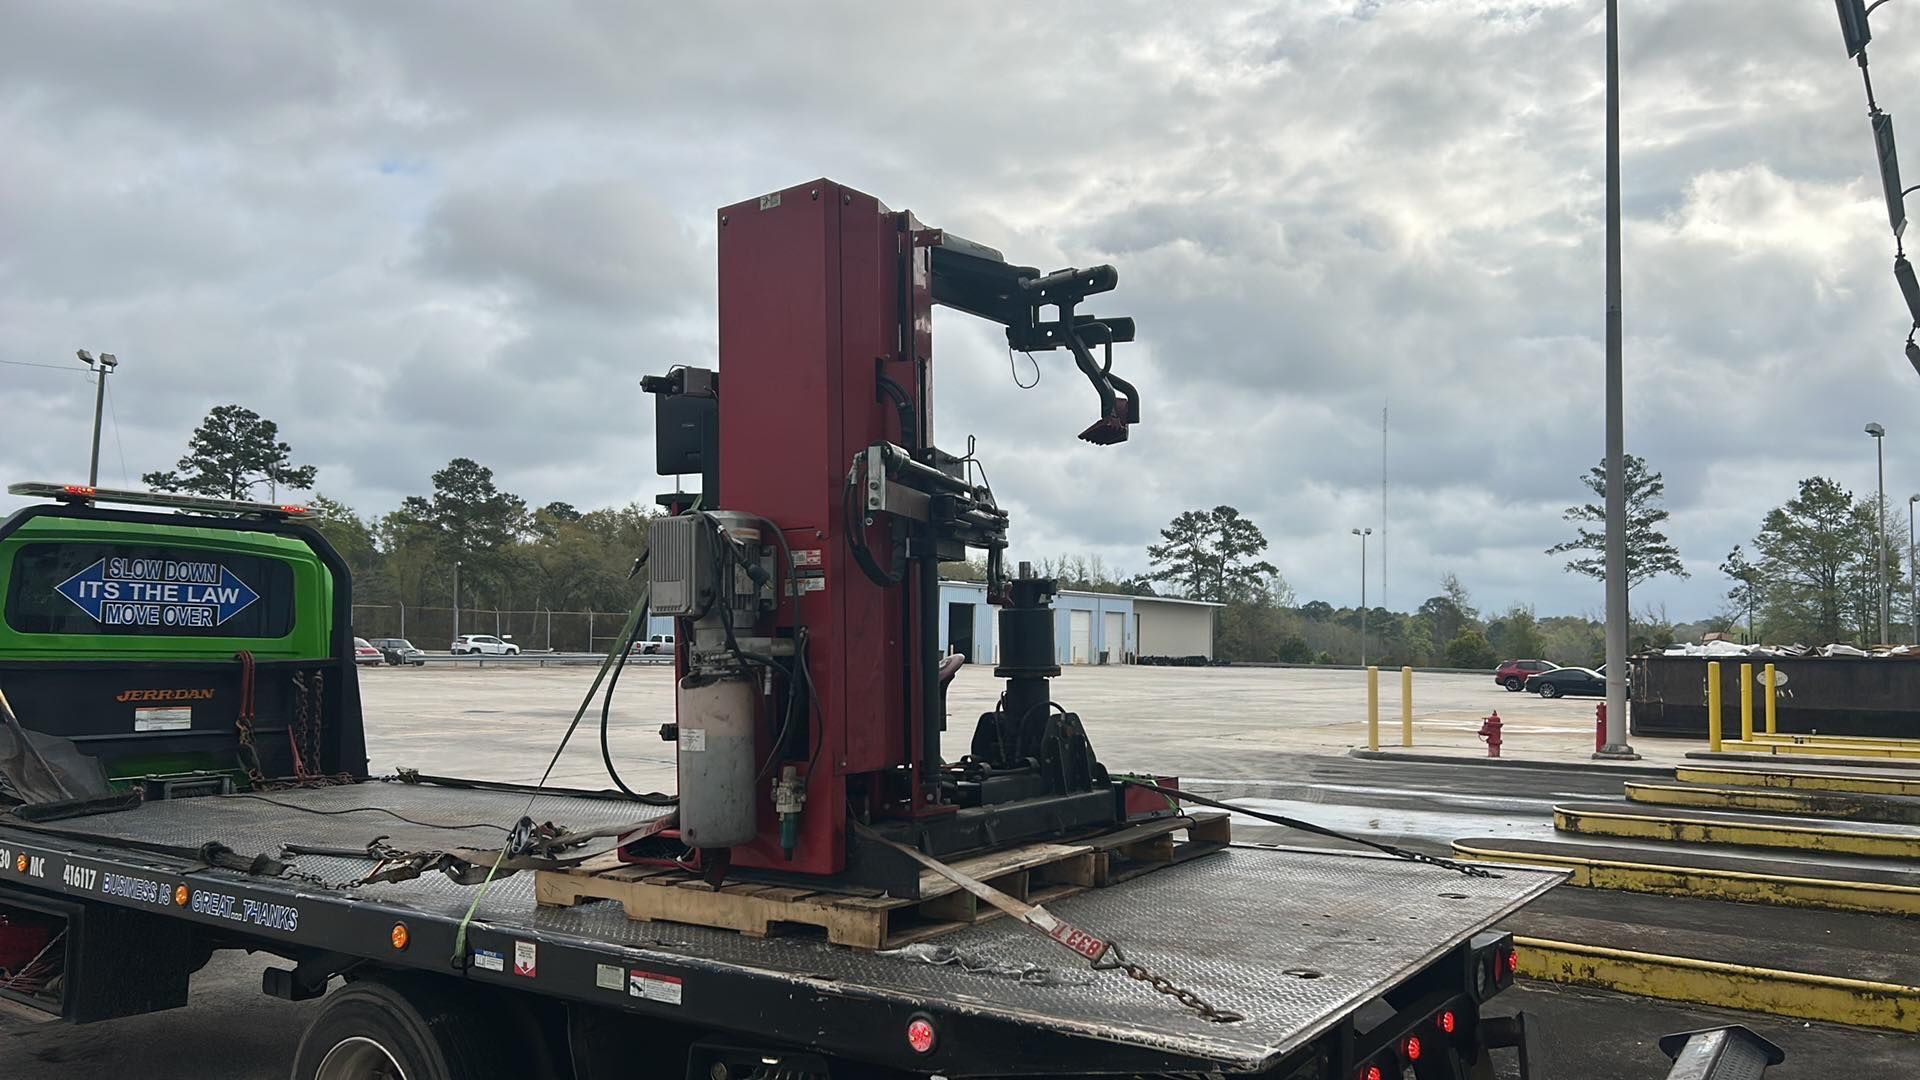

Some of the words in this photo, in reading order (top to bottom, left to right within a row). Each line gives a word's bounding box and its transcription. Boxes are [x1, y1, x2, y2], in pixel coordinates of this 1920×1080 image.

[109, 557, 162, 580] SLOW
[165, 561, 216, 582] DOWN
[79, 581, 120, 599] ITS
[128, 583, 178, 601] THE
[187, 587, 239, 604] LAW
[105, 604, 160, 625] MOVE
[163, 606, 213, 626] OVER
[29, 856, 46, 878] MC
[62, 864, 97, 890] 416117
[102, 872, 158, 903] BUSINESS
[158, 883, 172, 906] IS
